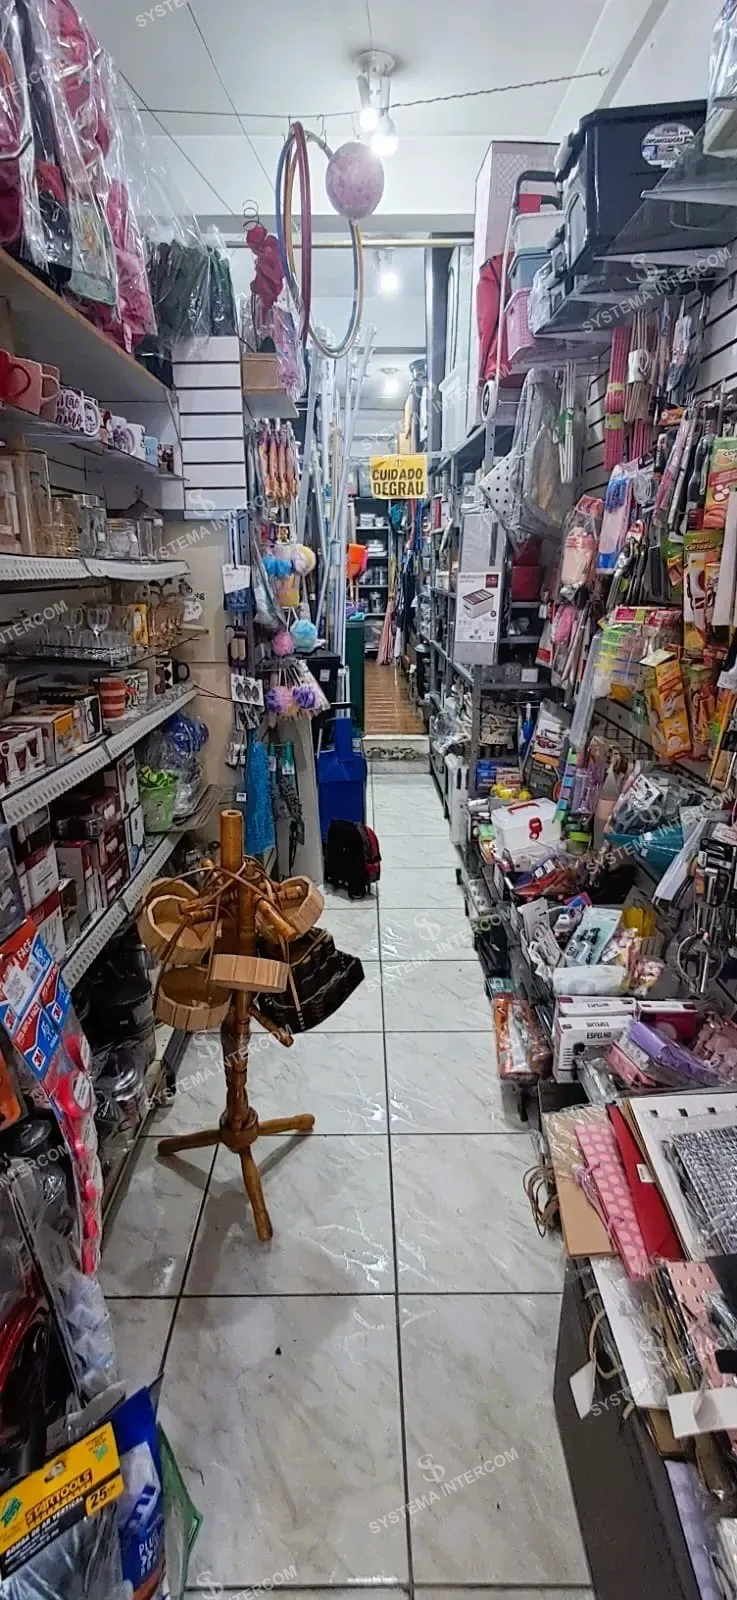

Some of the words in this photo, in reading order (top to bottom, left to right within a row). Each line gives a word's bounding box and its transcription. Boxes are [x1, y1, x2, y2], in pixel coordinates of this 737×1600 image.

[372, 467, 423, 480] CUIDADO
[373, 481, 424, 496] DEGRAU
[586, 1031, 612, 1040] ESPELHO
